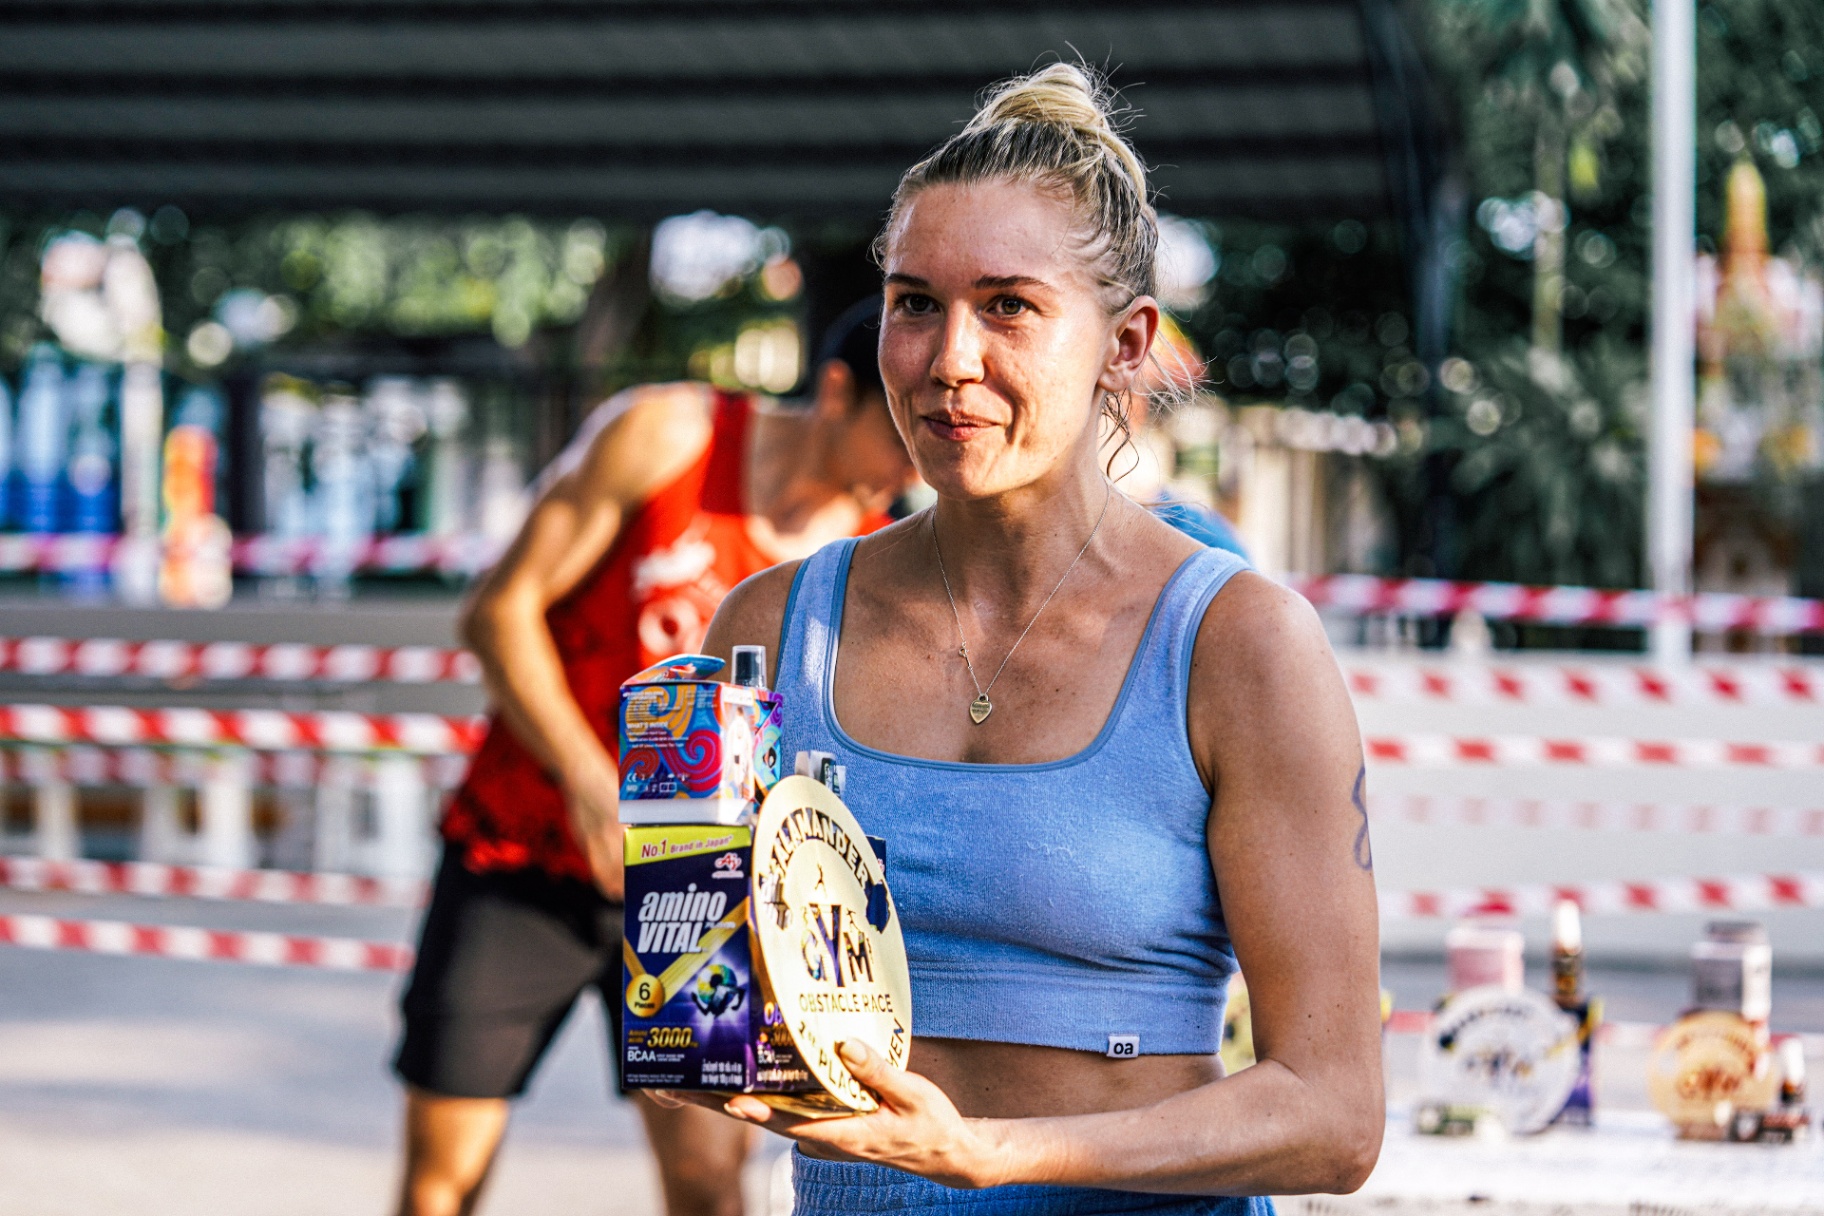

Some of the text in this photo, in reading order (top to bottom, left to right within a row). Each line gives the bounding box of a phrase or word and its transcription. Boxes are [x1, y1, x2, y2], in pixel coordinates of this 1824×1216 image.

[670, 844, 694, 854] Brand
[638, 883, 727, 922] amino
[637, 922, 702, 953] VITAL
[801, 903, 873, 988] GYM
[639, 982, 650, 1001] 6
[800, 993, 860, 1013] OBSTACLE
[862, 993, 894, 1013] RACE
[647, 1027, 692, 1048] 3000
[627, 1050, 656, 1062] BCAA
[1113, 1042, 1134, 1055] oa
